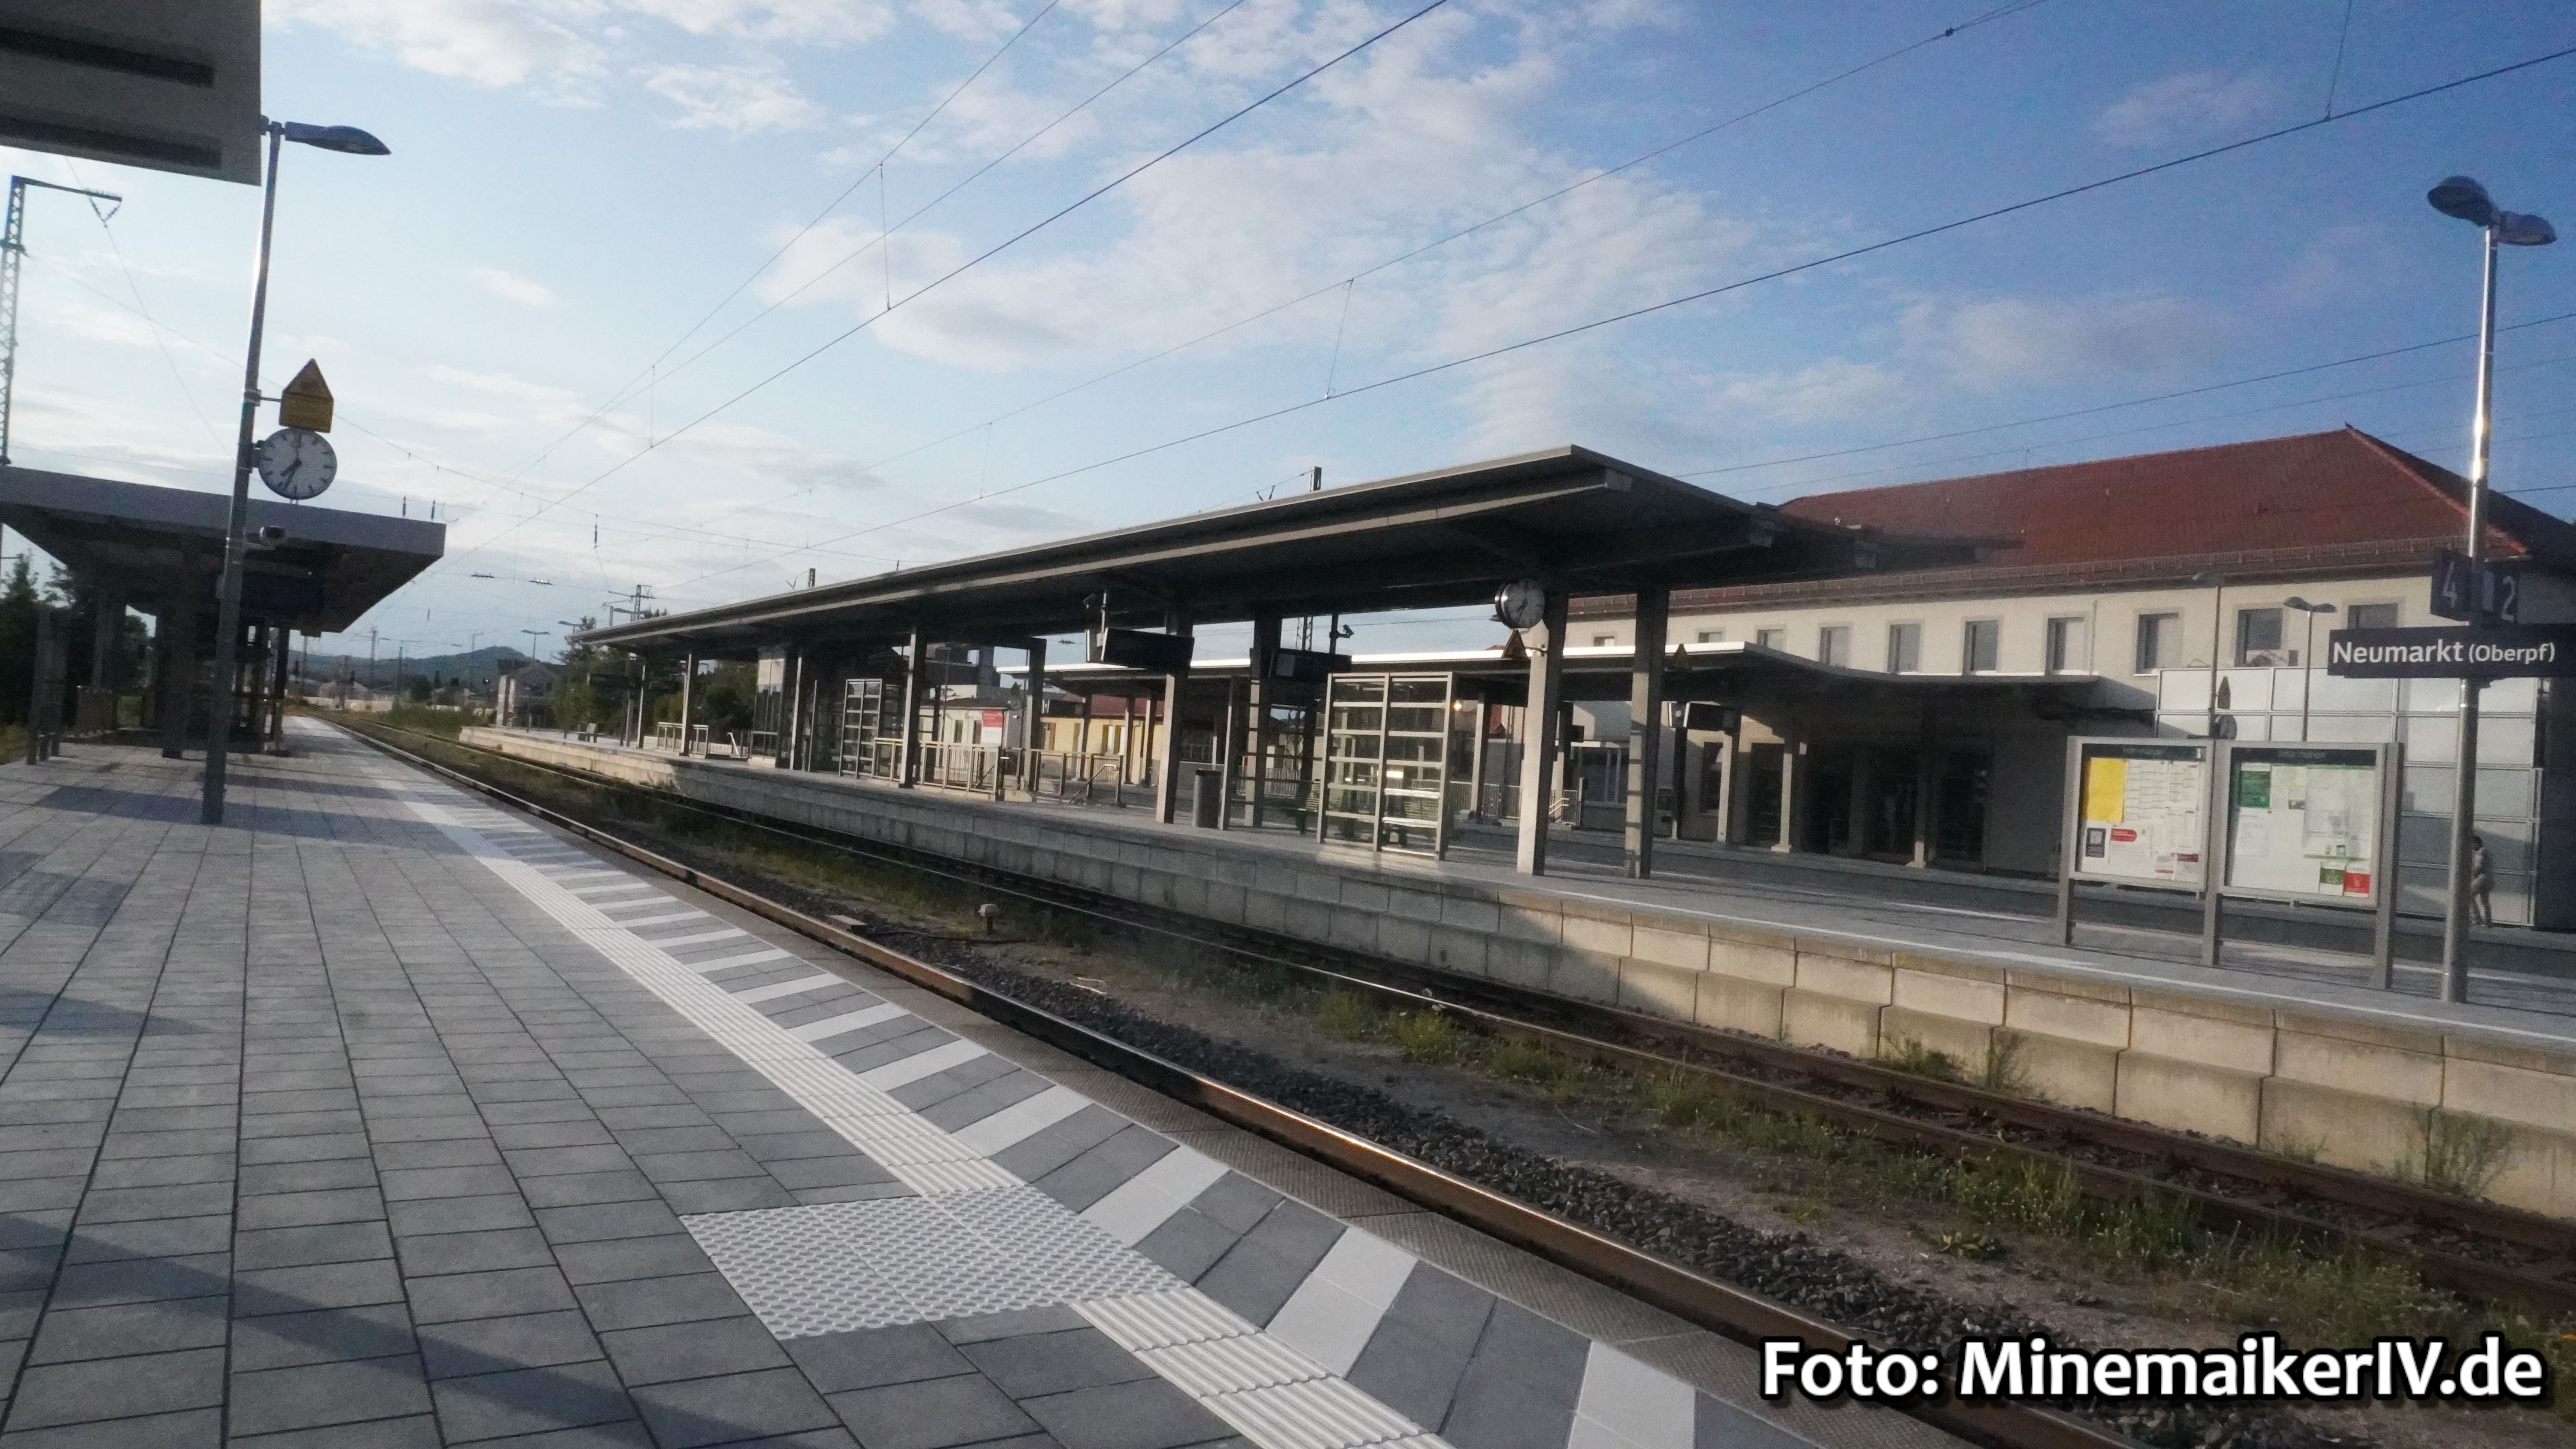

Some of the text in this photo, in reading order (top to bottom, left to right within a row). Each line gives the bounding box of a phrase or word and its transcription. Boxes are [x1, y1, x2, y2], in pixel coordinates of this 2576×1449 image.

[2442, 561, 2458, 608] 4
[2500, 575, 2516, 623] 2
[2332, 638, 2555, 664] Neumarkt (Oberpf)
